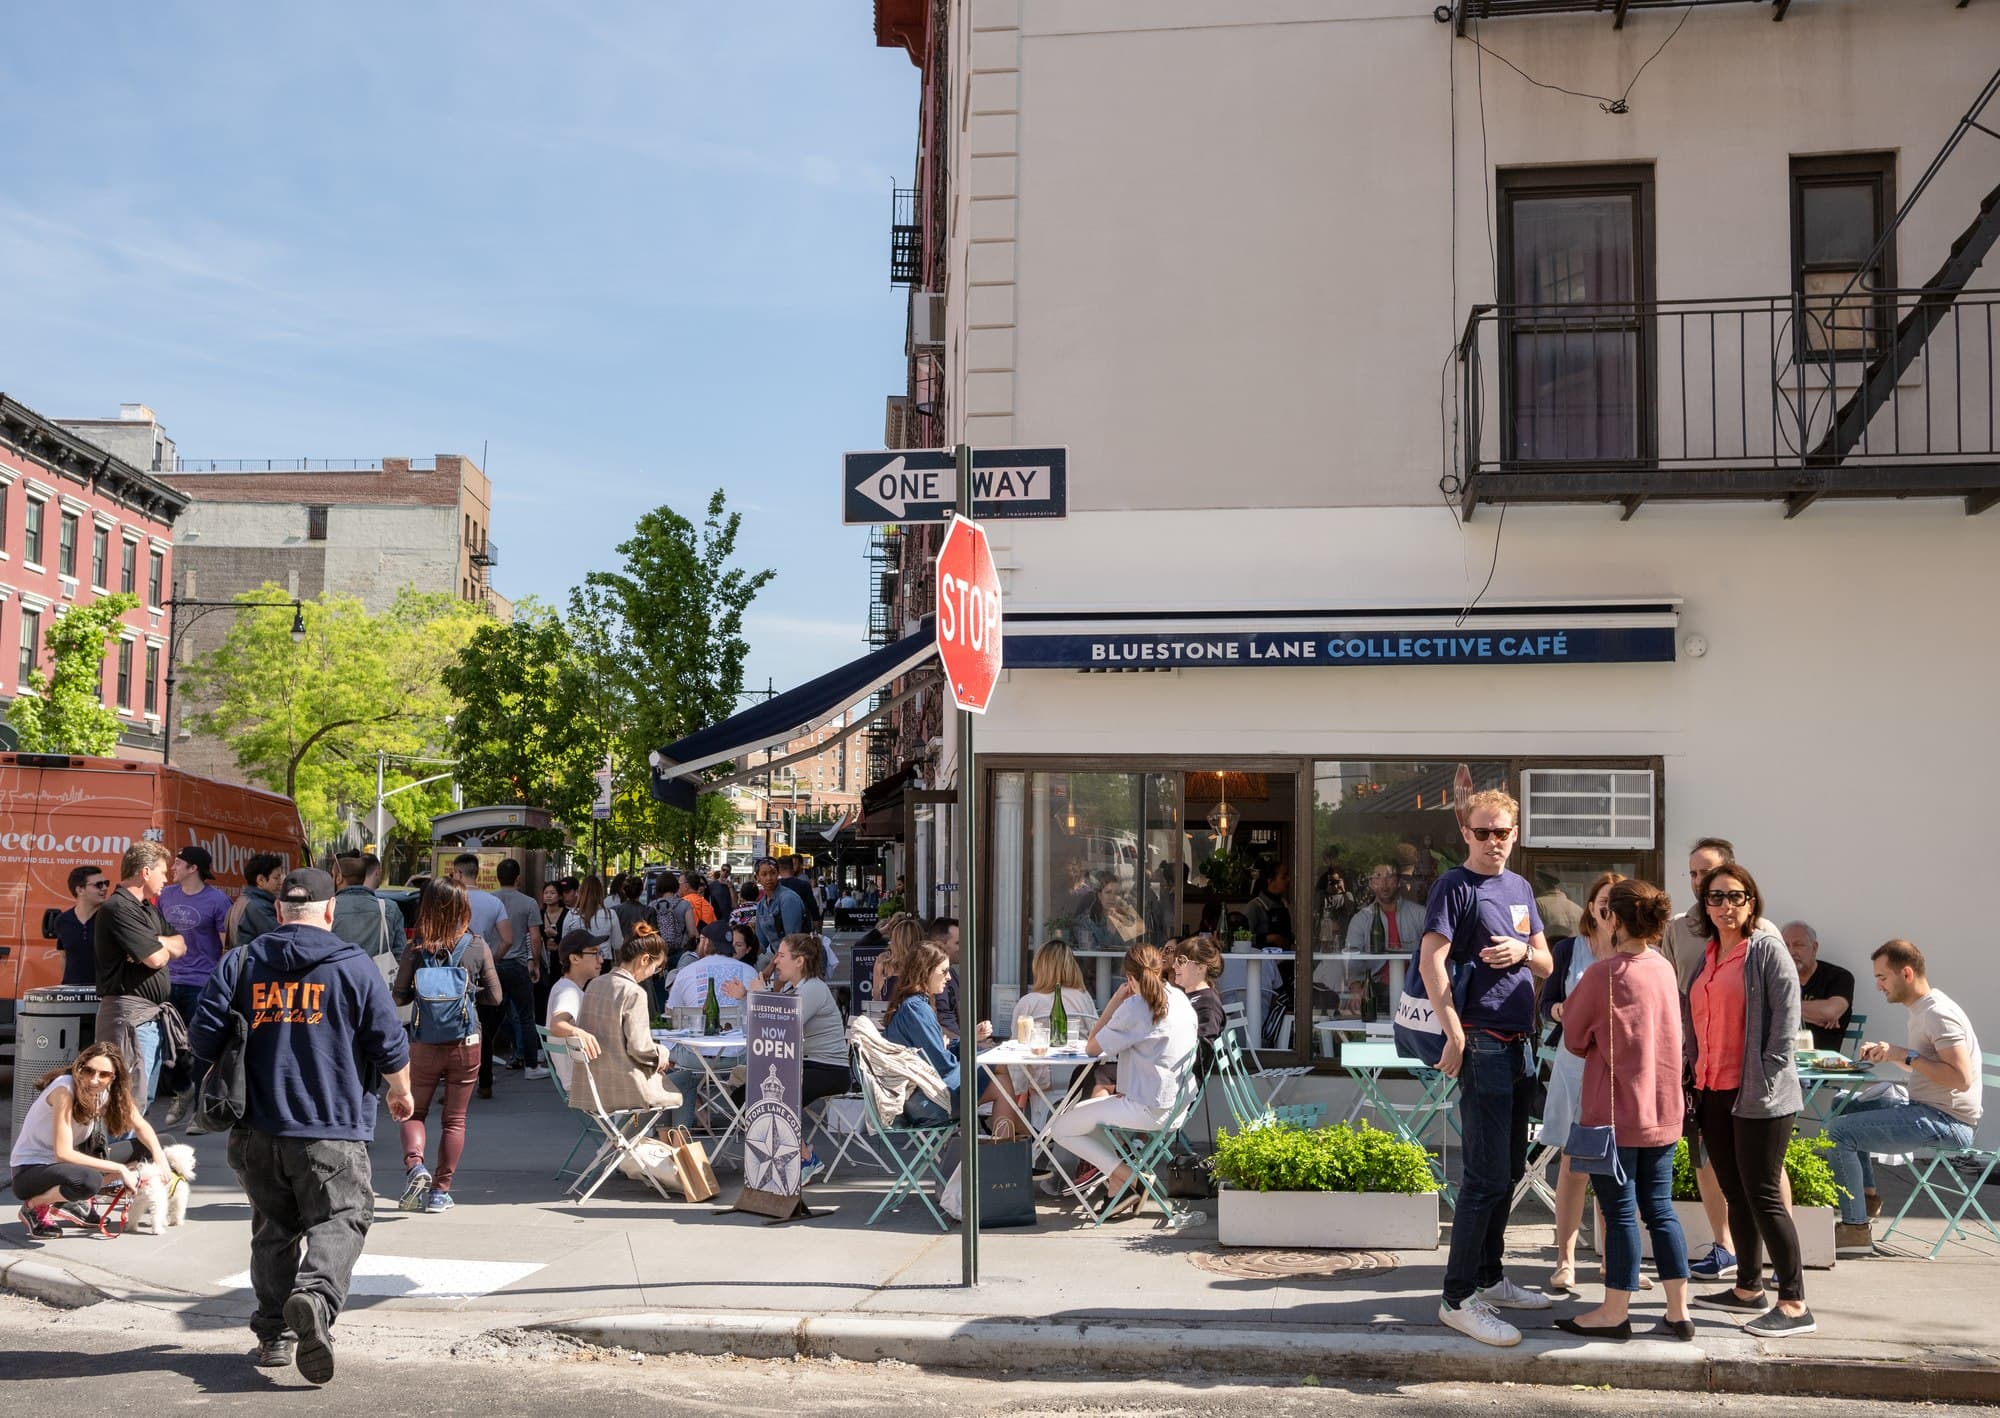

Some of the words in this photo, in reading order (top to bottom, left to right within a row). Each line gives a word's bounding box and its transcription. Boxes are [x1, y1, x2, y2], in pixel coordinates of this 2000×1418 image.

[879, 473, 939, 500] ONE
[972, 470, 1037, 498] WAY
[942, 573, 998, 654] STOP
[1092, 642, 1240, 660] BLUESTONE
[1250, 641, 1316, 658] LANE
[1327, 638, 1492, 657] COLLECTIVE
[1499, 632, 1568, 656] CAFÉ
[0, 831, 131, 854] eco.com
[252, 981, 299, 1009] EAT
[302, 983, 325, 1009] IT
[251, 1010, 284, 1030] You'll
[751, 1004, 783, 1014] BLUESTONE
[783, 1007, 799, 1015] LANE
[758, 1012, 776, 1020] COFFEE
[761, 1027, 786, 1040] NOW
[753, 1038, 795, 1059] OPEN
[767, 1104, 785, 1117] LANE
